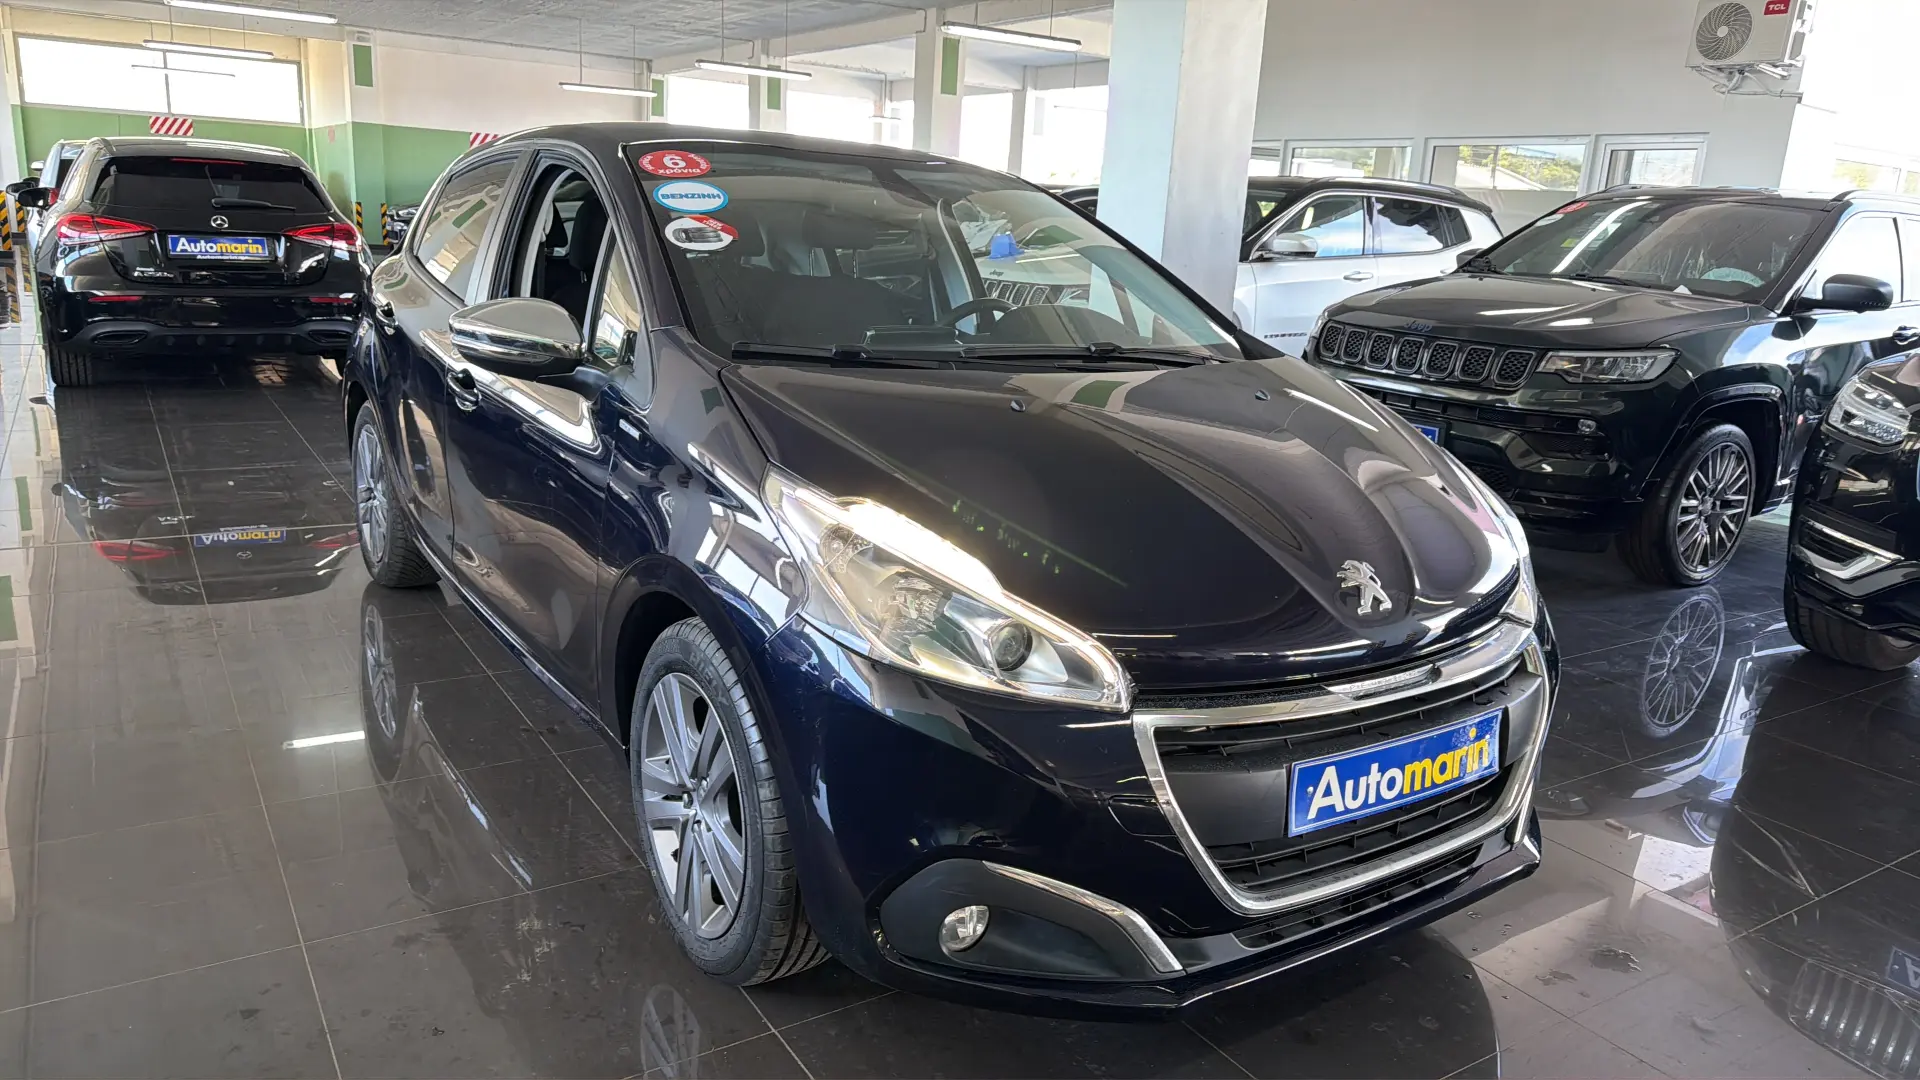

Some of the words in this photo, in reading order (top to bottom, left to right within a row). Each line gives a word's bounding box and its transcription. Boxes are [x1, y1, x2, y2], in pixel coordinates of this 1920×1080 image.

[663, 155, 687, 168] 6
[176, 237, 262, 254] Automarin
[1307, 727, 1490, 820] Automarin
